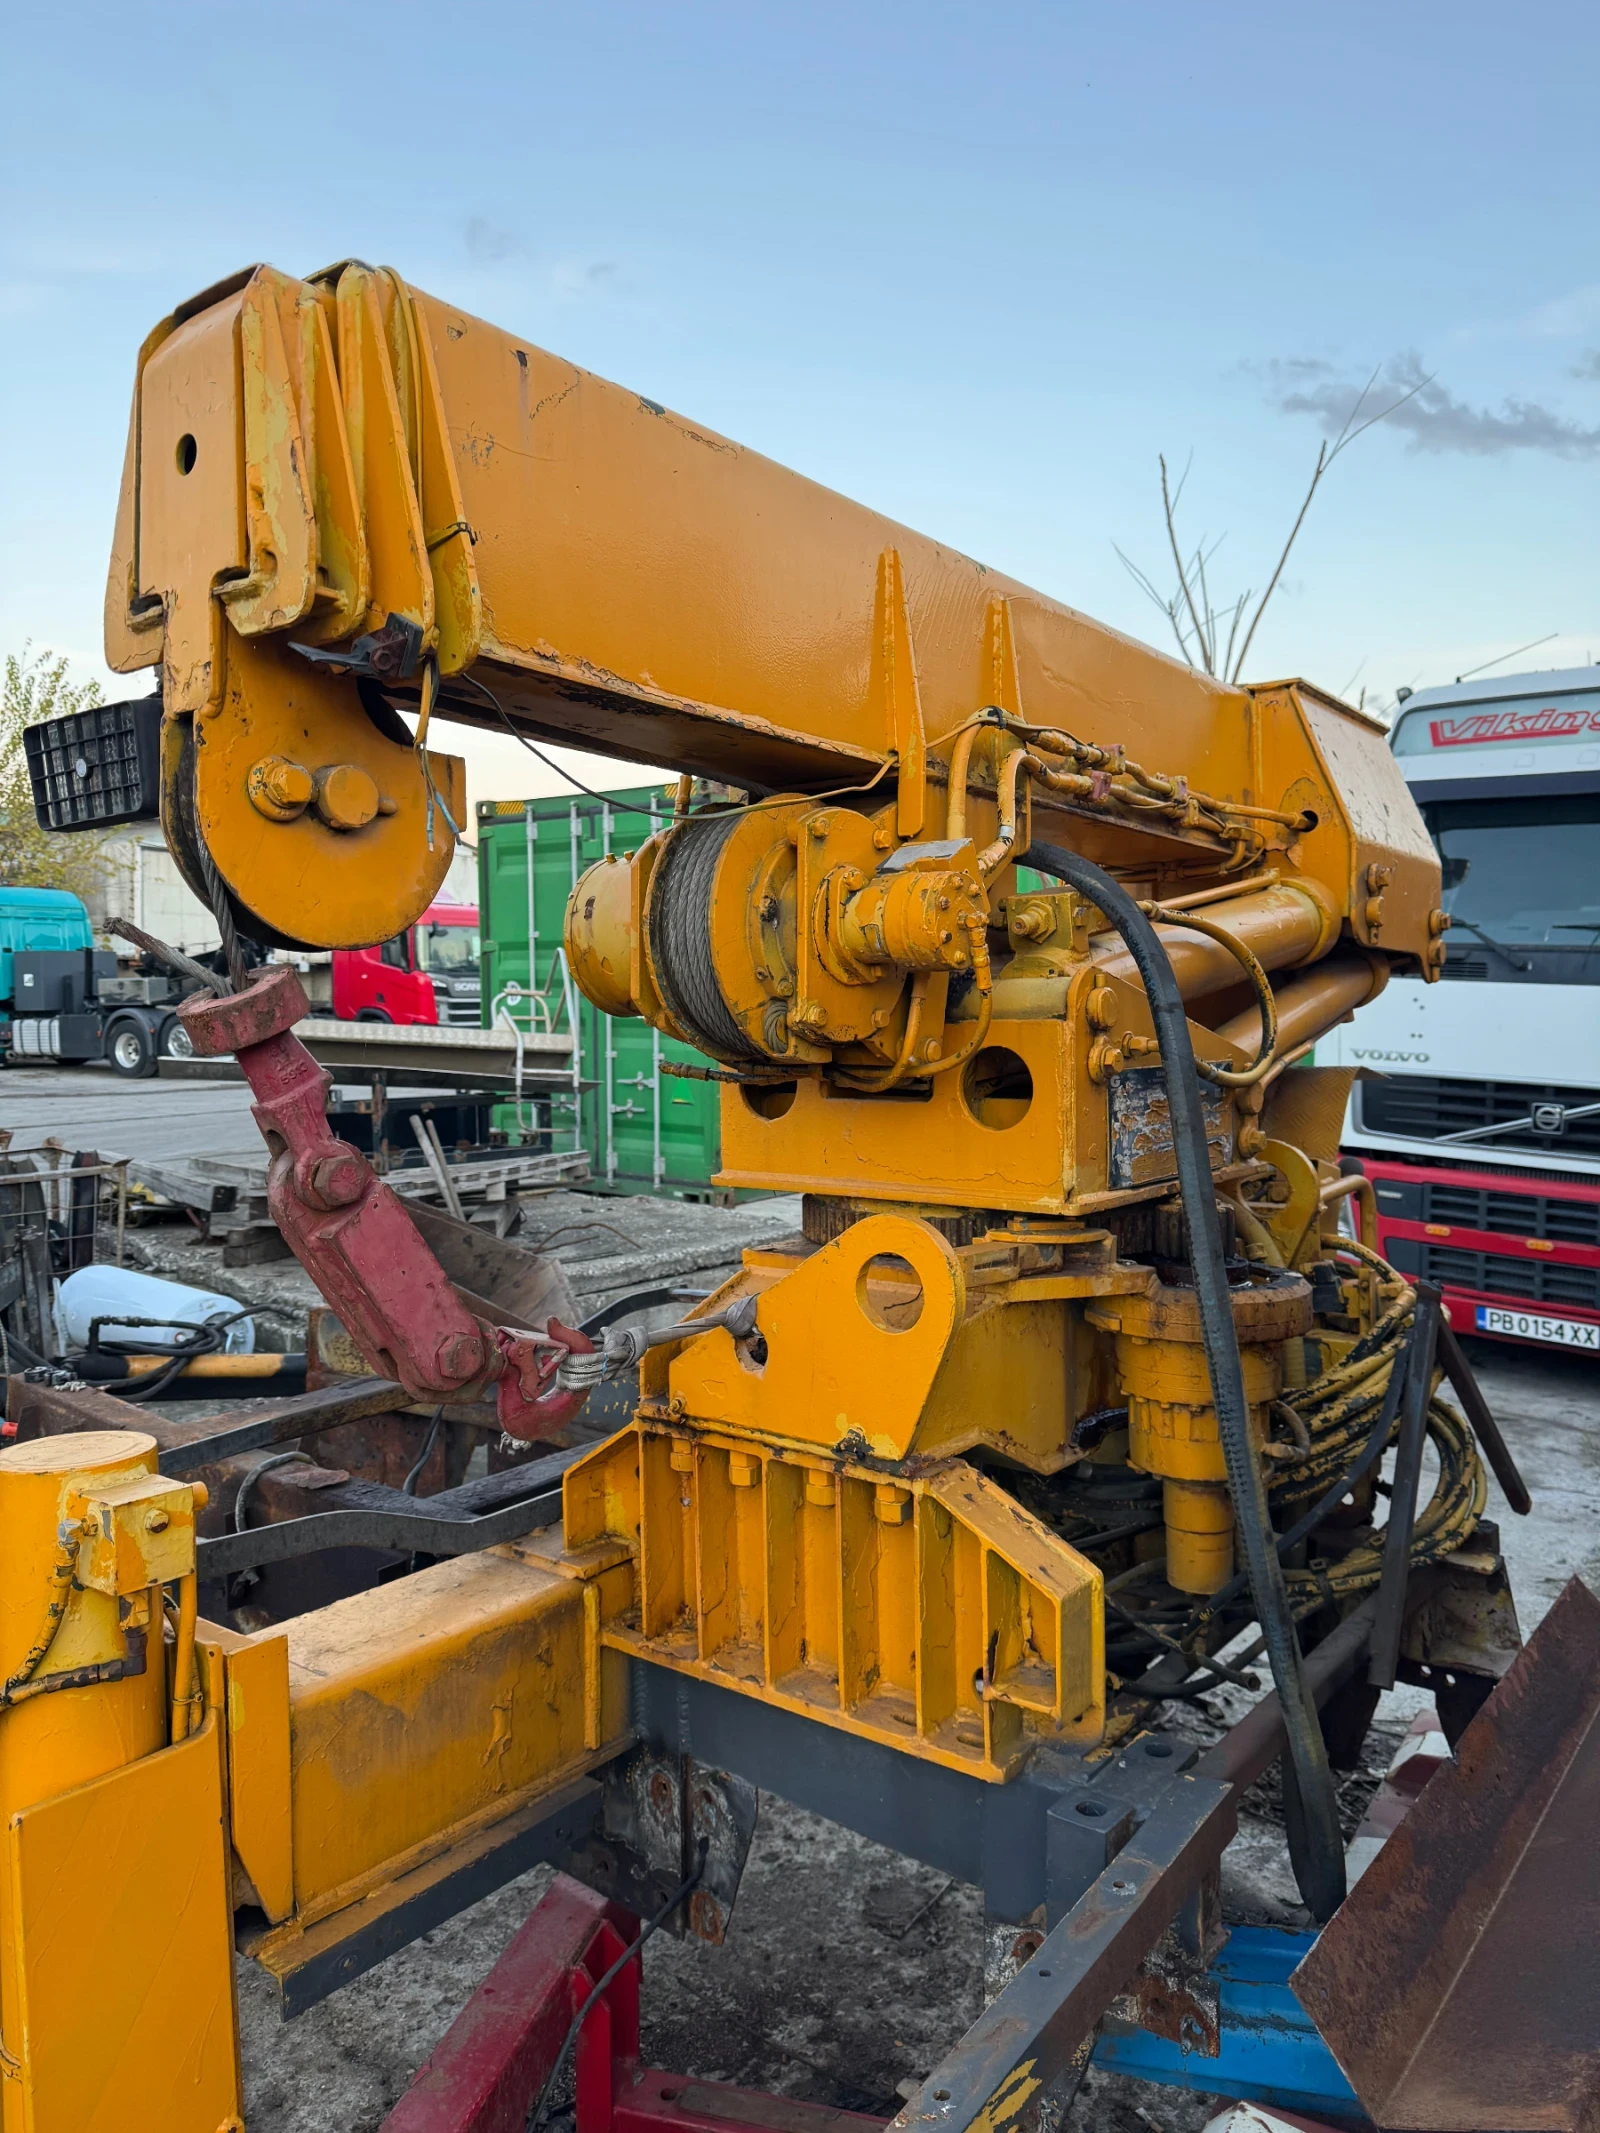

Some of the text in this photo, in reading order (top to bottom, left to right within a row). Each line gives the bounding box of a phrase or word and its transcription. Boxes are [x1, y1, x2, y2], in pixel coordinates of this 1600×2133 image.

[1350, 1047, 1430, 1063] VOLVO
[1489, 1311, 1595, 1346] PB 0154 XX
